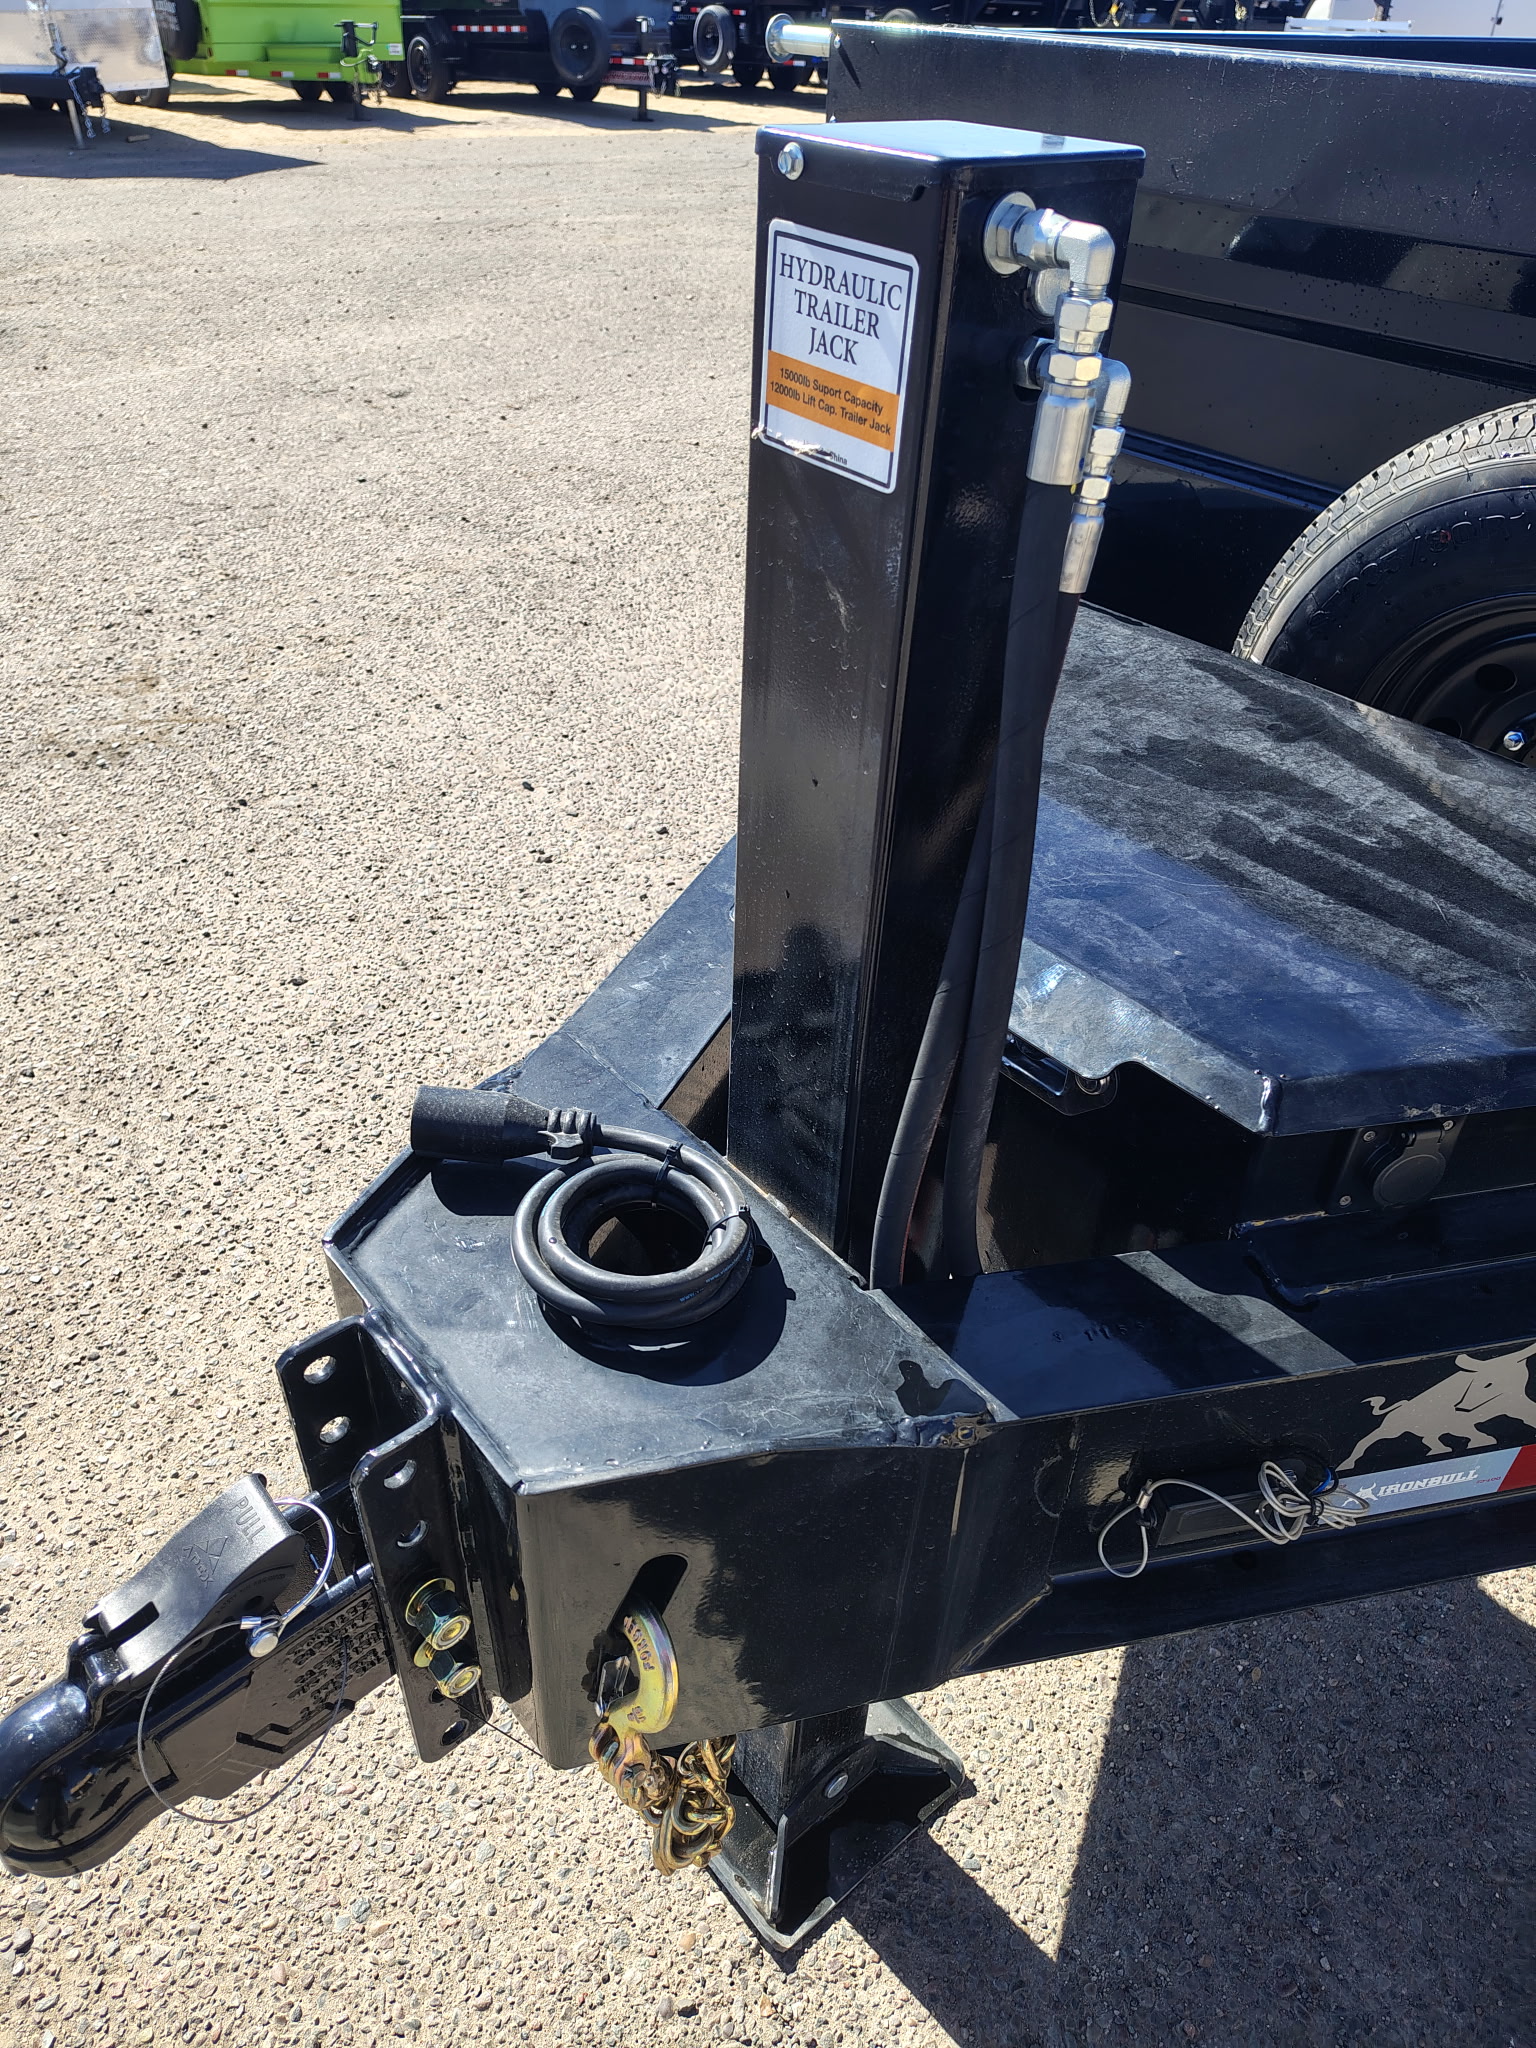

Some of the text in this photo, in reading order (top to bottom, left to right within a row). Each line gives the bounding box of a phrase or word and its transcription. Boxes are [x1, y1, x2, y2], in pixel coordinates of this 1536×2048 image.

[779, 253, 902, 311] HYDRAULIC
[794, 288, 880, 339] TRAILER
[808, 327, 857, 365] JACK
[770, 381, 891, 436] 12000lb Lift Cap. Trailer Jack
[780, 367, 883, 416] 15000lb Suport Capacity
[1376, 1469, 1479, 1498] IRONBULL
[229, 1495, 266, 1545] PULL
